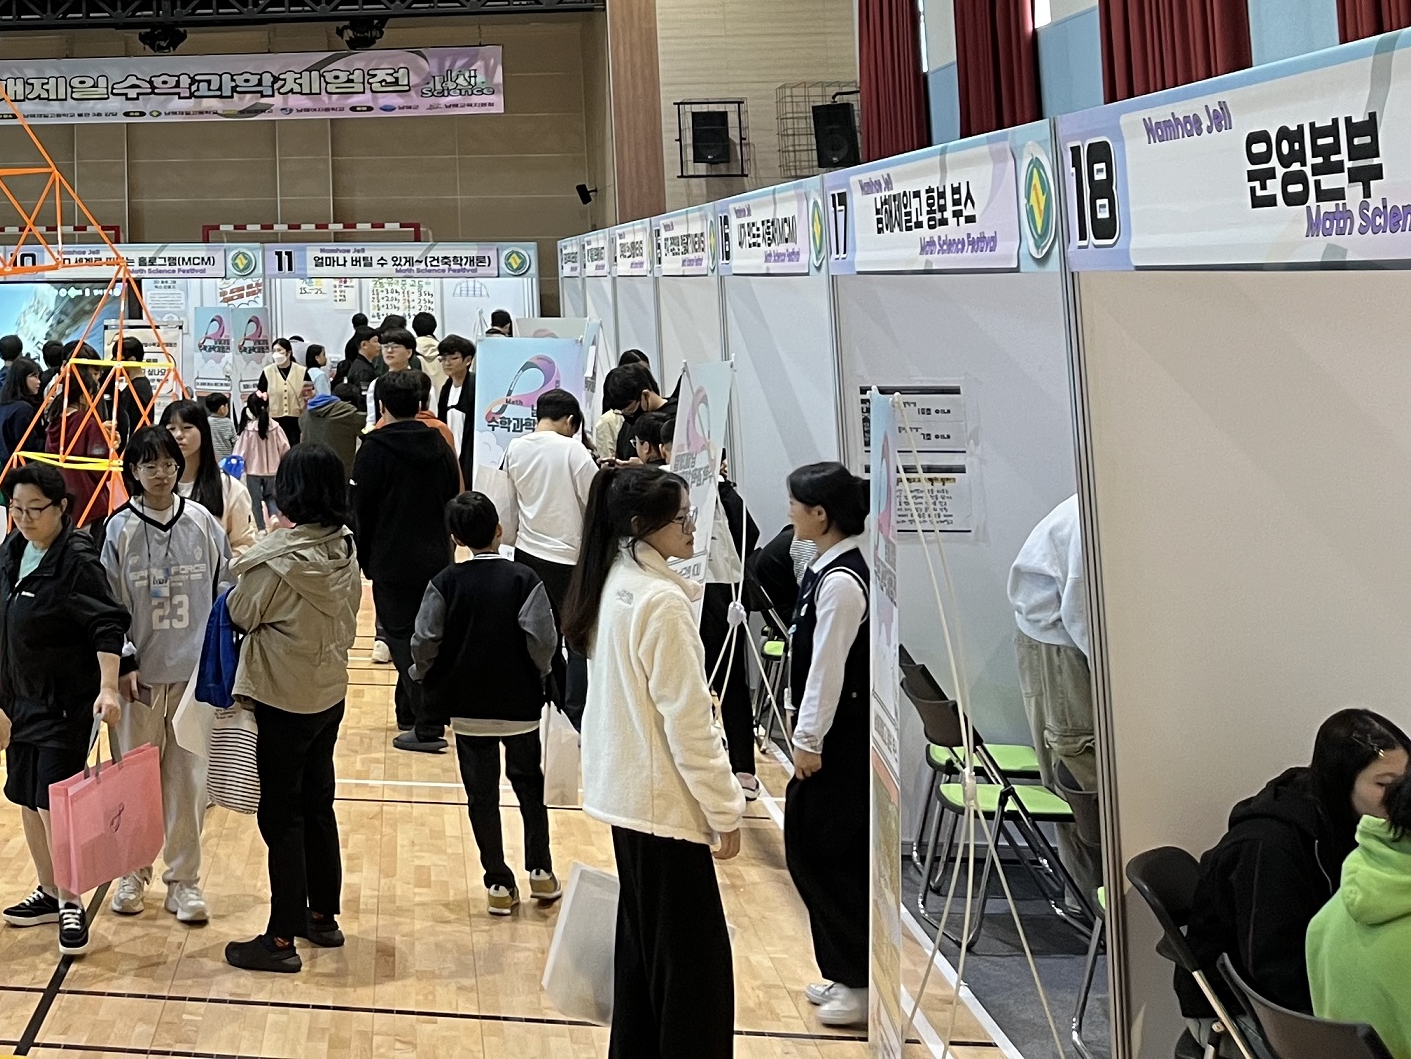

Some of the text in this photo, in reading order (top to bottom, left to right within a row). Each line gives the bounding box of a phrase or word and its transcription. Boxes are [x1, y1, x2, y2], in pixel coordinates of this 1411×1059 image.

[421, 86, 495, 98] Science
[1143, 100, 1233, 145] Namhae Jell
[1246, 111, 1384, 210] 운영본부
[874, 180, 977, 234] 남해제일고 홍보 부스
[1070, 138, 1120, 246] 18
[831, 191, 848, 260] 17
[1306, 201, 1354, 238] Math
[137, 255, 215, 267] 홀로그램(MCM)
[938, 233, 966, 255] Science
[967, 231, 997, 254] Festival
[274, 250, 294, 274] 11
[313, 255, 491, 268] 얼마나 버틸 수 있게~(건축학개론)
[487, 416, 536, 433] 수학과학
[152, 594, 190, 630] 23
